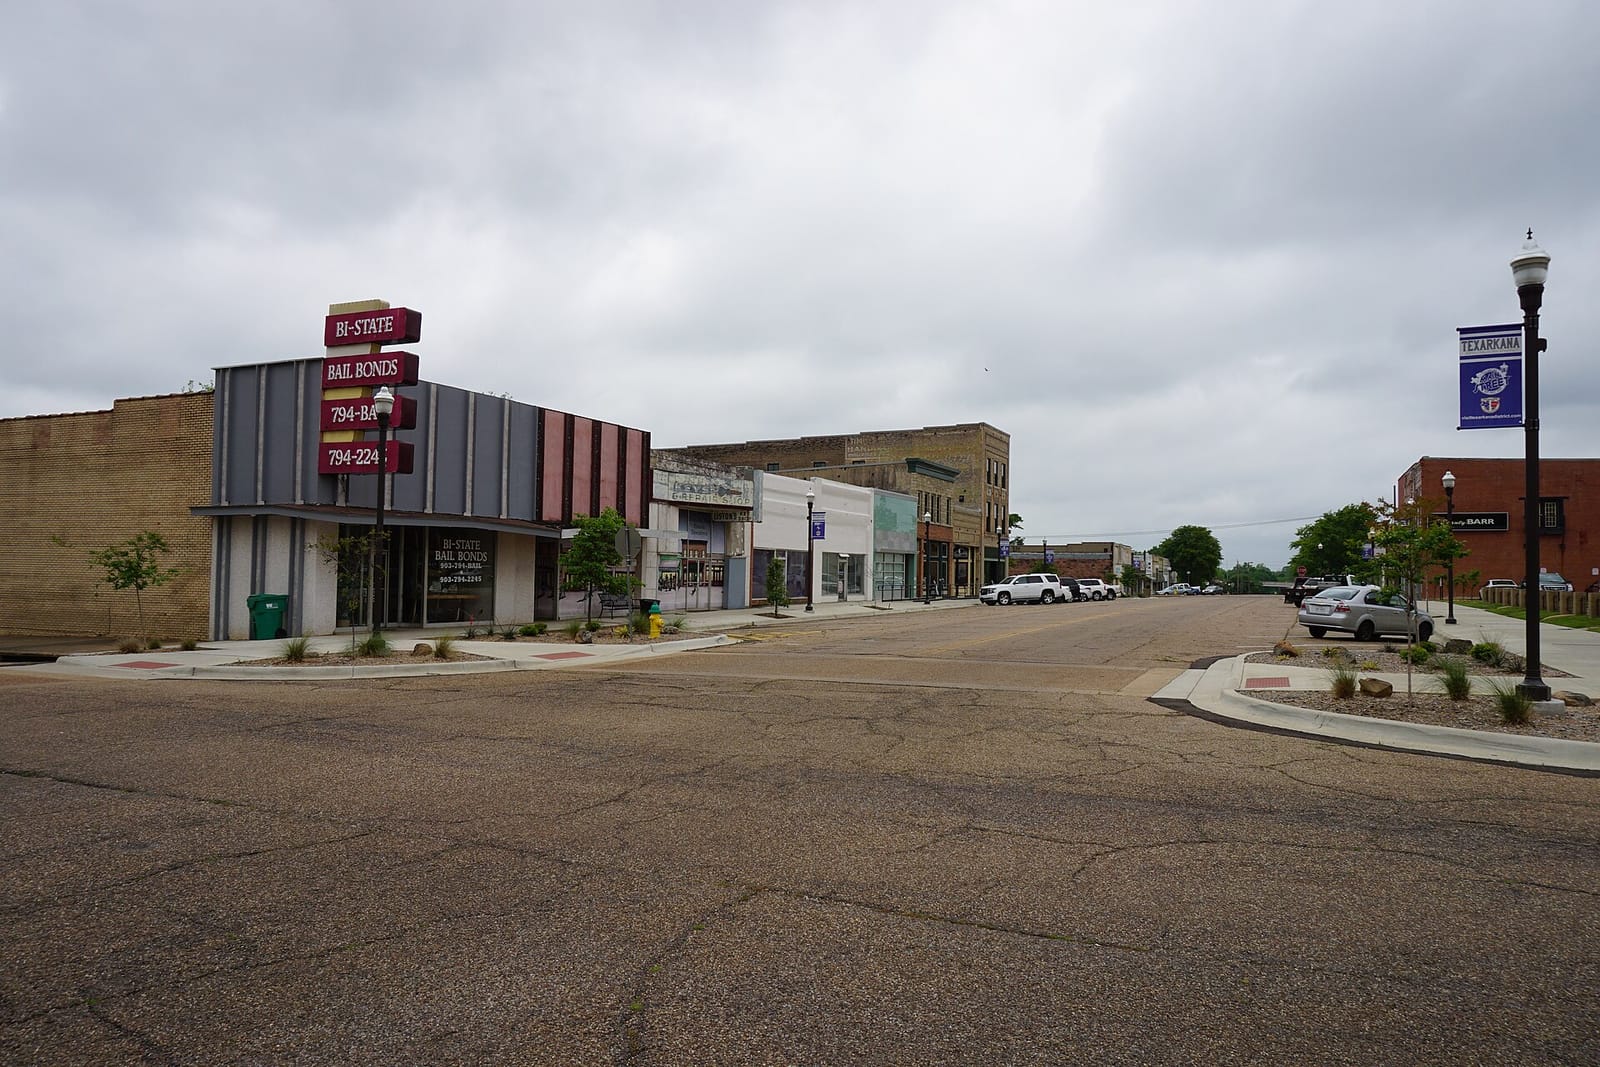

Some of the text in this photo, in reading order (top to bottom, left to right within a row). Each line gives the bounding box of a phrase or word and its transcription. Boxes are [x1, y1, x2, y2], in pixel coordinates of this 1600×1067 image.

[335, 316, 394, 338] BI-STATE
[1461, 337, 1520, 352] TEXARKANA
[327, 359, 398, 380] BAIL BONDS
[331, 404, 379, 423] 794-BA
[328, 447, 388, 466] 794-224
[443, 539, 481, 550] BI-STATE
[435, 551, 488, 562] BAIL BONDS
